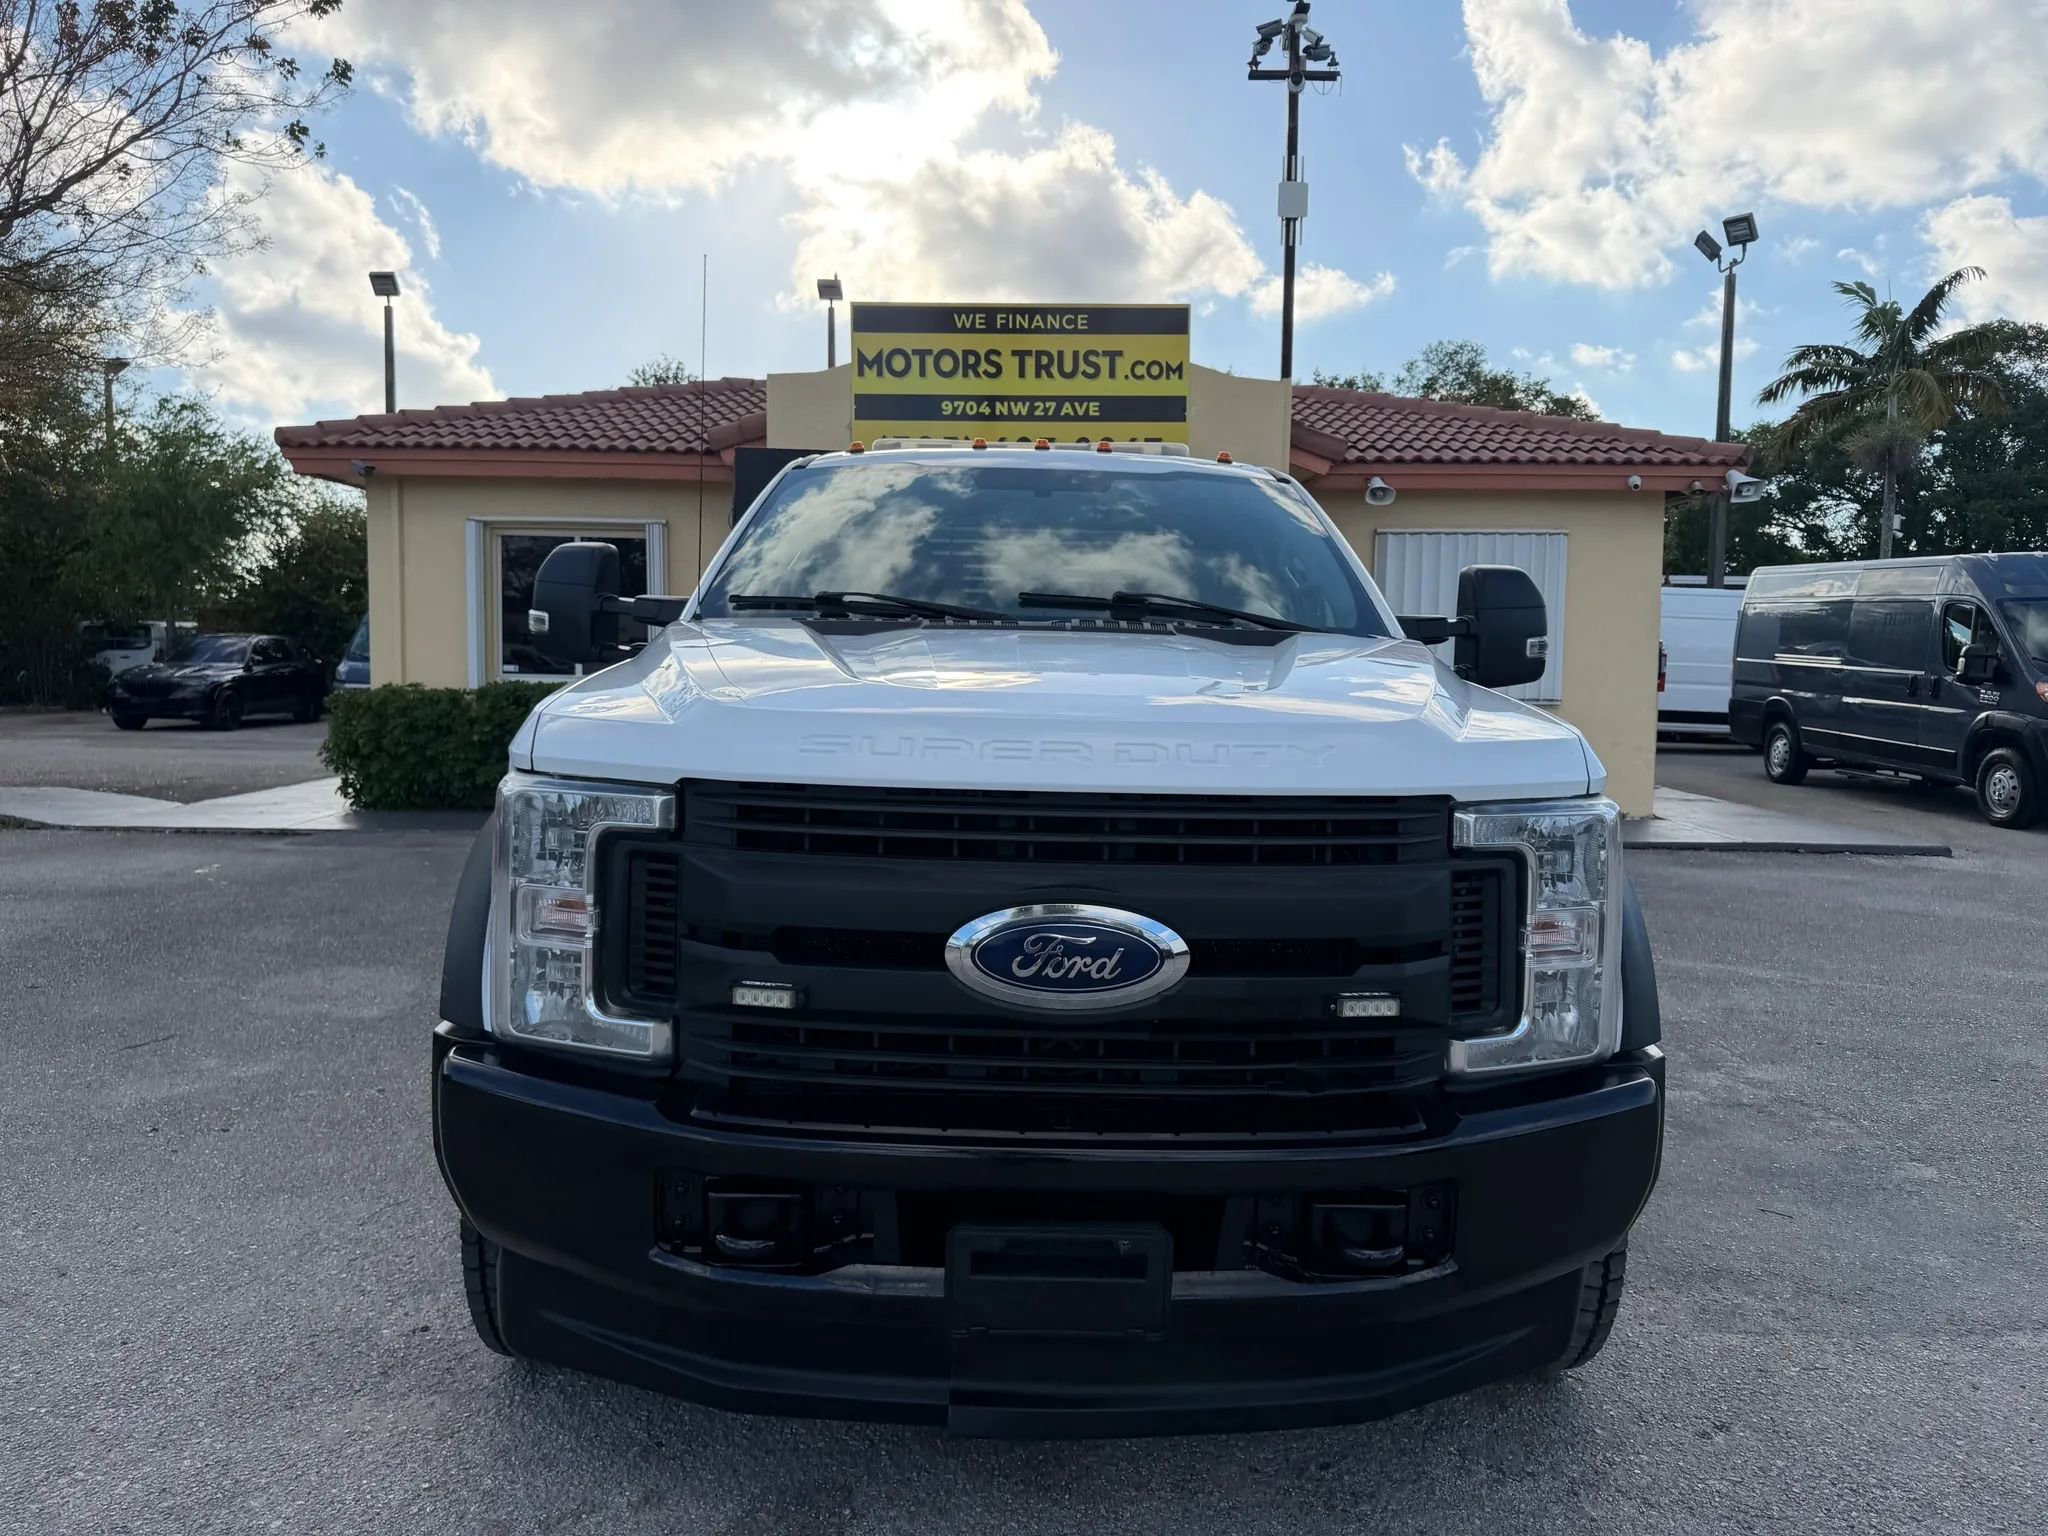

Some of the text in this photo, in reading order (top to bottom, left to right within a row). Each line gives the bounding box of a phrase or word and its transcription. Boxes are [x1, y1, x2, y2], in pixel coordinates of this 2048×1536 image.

[953, 313, 1089, 330] WE FINANCE
[856, 347, 1003, 379] MOTORS
[941, 400, 1101, 417] 9704 NW 27 AVE
[799, 734, 1337, 768] SUPER DUTY
[1011, 932, 1125, 980] Ford
